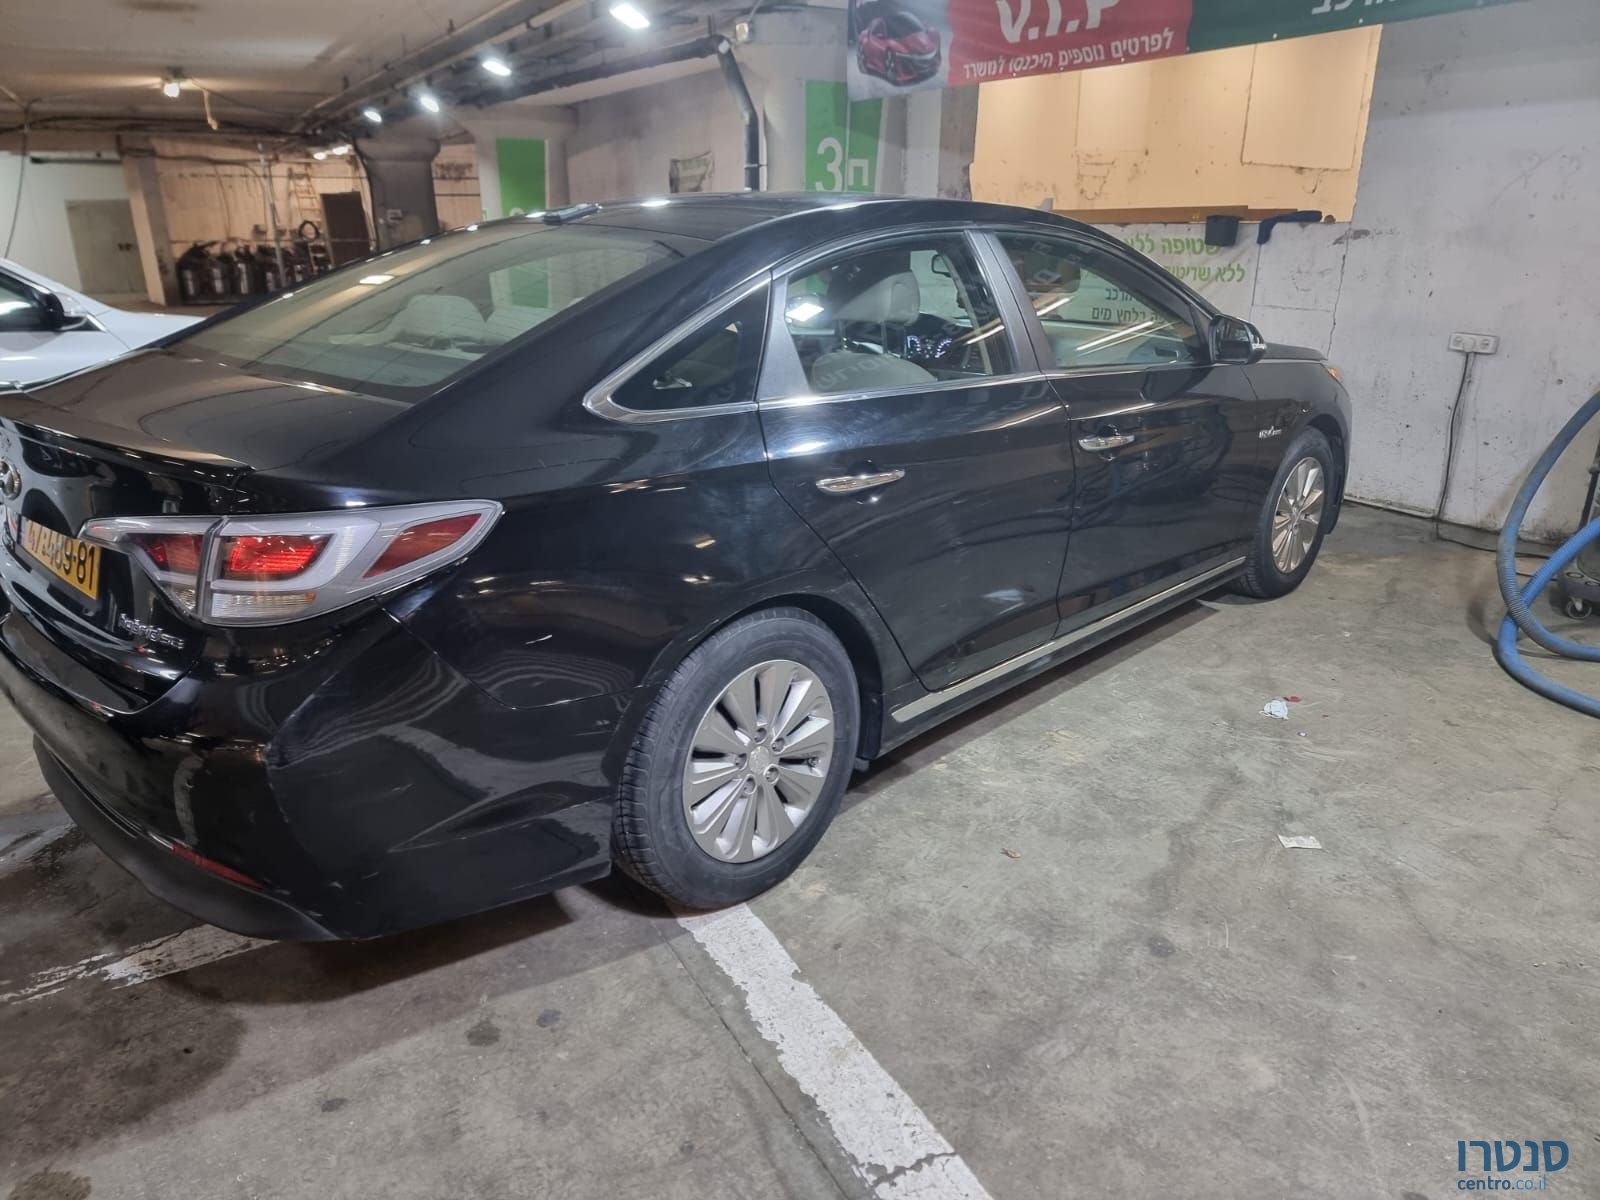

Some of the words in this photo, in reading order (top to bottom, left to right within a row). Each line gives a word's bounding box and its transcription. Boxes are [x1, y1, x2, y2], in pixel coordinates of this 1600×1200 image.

[1111, 27, 1174, 58] לפרטים
[1058, 44, 1104, 67] נוספים
[963, 56, 1006, 79] למשרד
[1165, 264, 1211, 281] שריטו
[1215, 264, 1246, 282] ללא
[1091, 307, 1112, 321] מים
